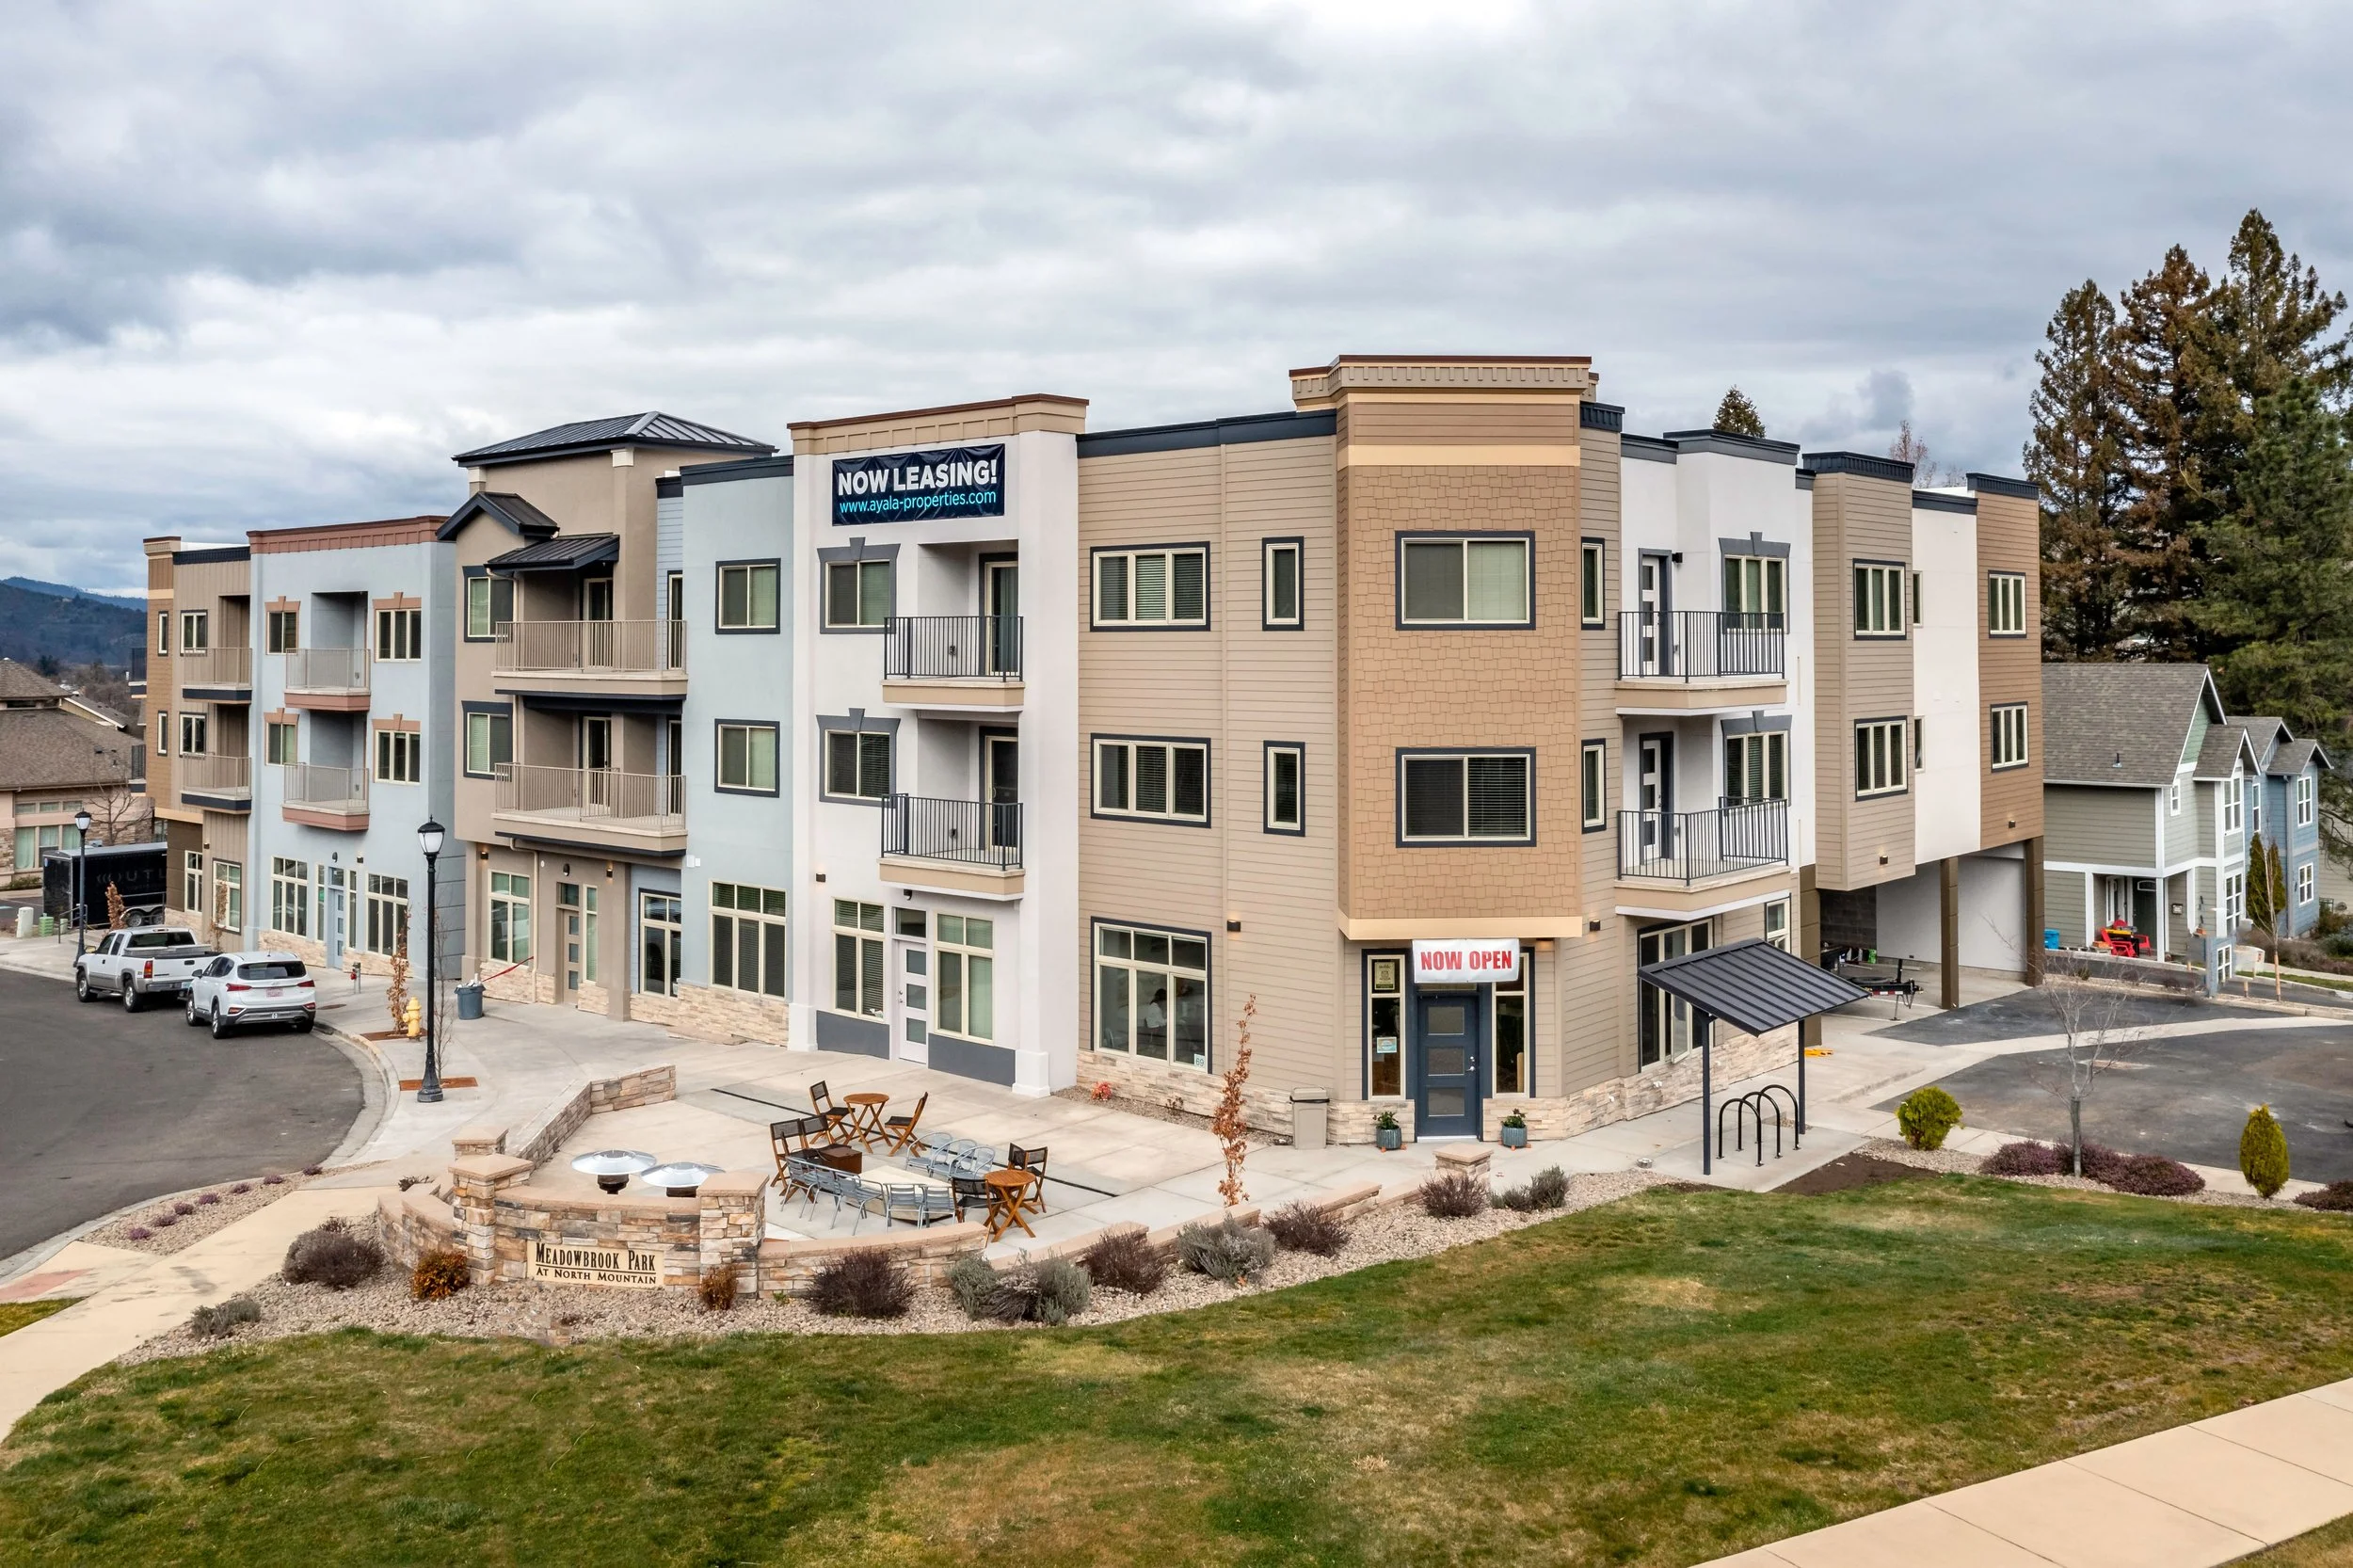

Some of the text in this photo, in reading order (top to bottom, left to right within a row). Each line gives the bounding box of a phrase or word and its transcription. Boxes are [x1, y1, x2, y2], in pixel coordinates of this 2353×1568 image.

[838, 459, 998, 496] NOW LEASING!
[840, 490, 997, 514] www.ayala-properties.com
[1420, 951, 1513, 971] NOW OPEN
[536, 1242, 656, 1272] MEADOWBROOK PARK
[536, 1267, 657, 1285] AT NORTH MOUNTAIN
